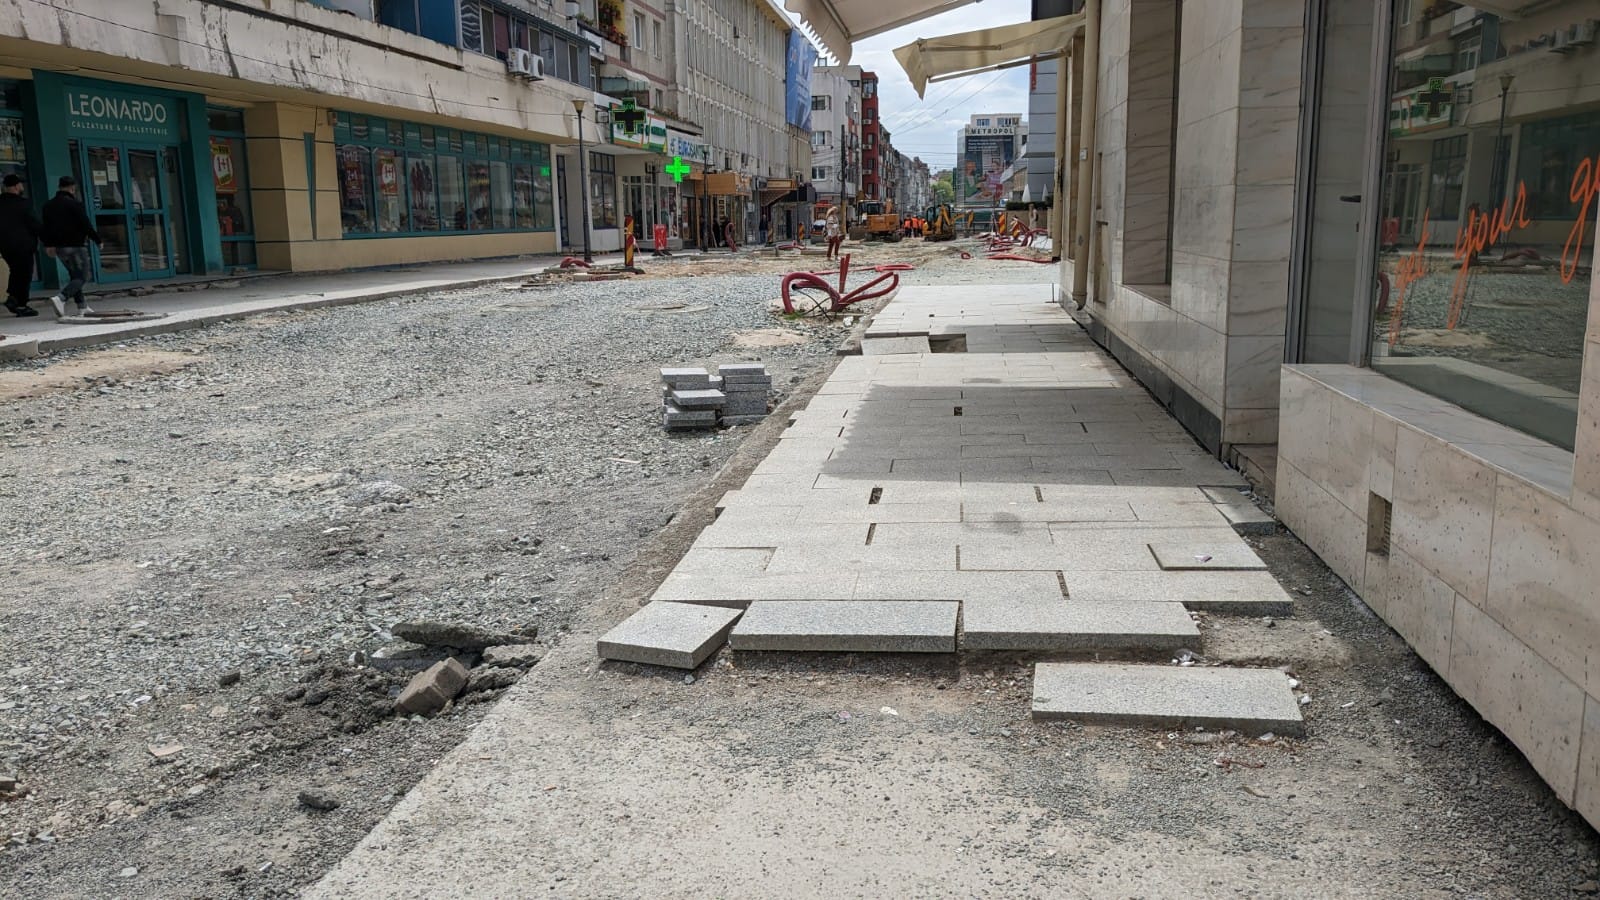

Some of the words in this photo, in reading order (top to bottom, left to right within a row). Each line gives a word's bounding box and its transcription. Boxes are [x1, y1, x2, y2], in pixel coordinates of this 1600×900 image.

[68, 93, 167, 124] LEONARDO
[71, 120, 113, 132] CALZATURE
[124, 125, 169, 136] PELLETTERIE
[1389, 207, 1431, 347] get
[1447, 179, 1531, 330] your
[1560, 155, 1600, 286] g
